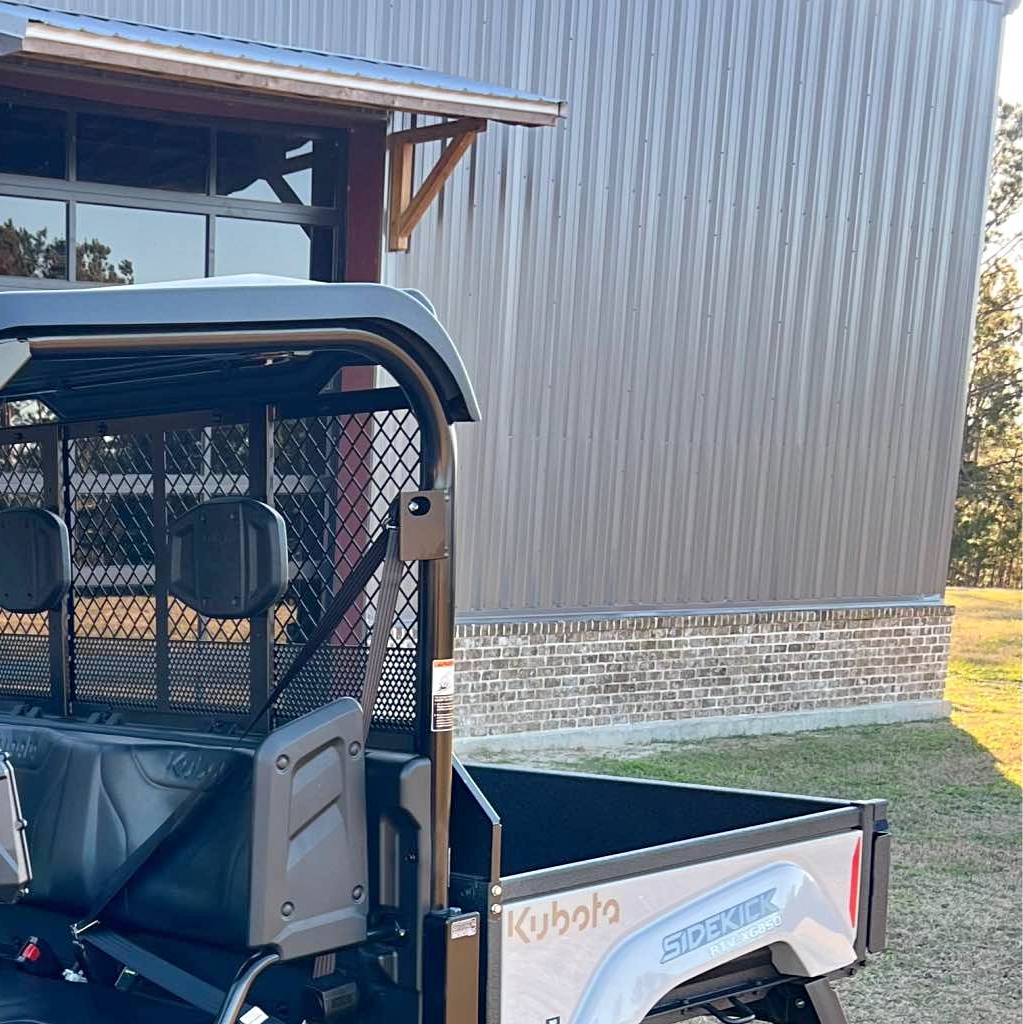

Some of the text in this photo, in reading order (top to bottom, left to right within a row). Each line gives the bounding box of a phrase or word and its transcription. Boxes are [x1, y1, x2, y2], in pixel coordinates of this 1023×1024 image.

[508, 892, 620, 945] Kubota
[660, 887, 781, 965] SIDEKICK
[709, 915, 782, 958] RTV-XG850
